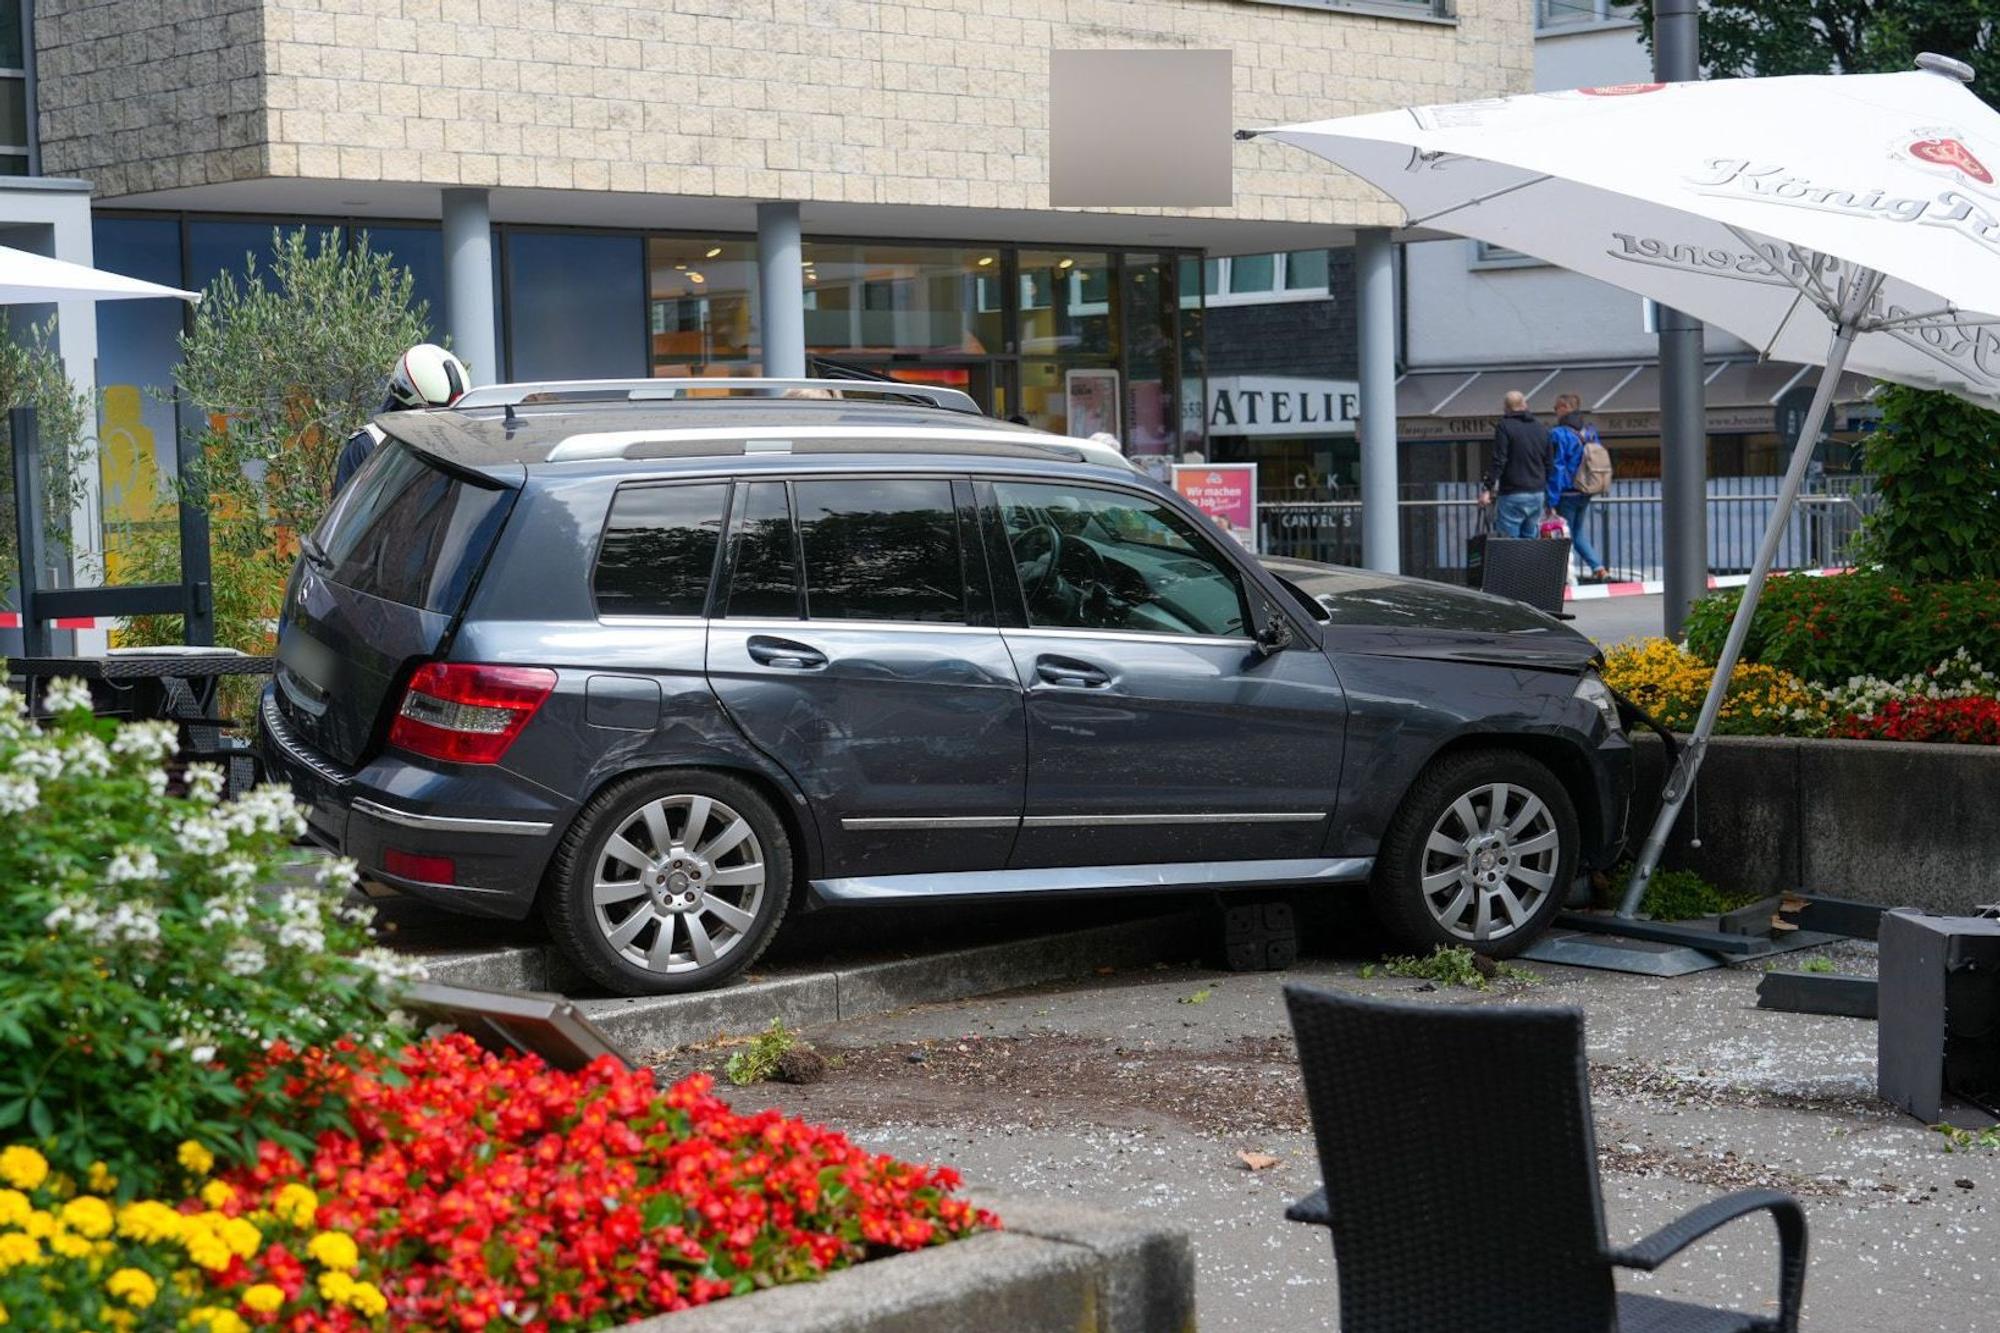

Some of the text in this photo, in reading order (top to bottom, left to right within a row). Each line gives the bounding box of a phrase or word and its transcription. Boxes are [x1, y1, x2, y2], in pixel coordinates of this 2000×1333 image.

[1683, 157, 1930, 222] König
[1185, 486, 1241, 497] Wir machen
